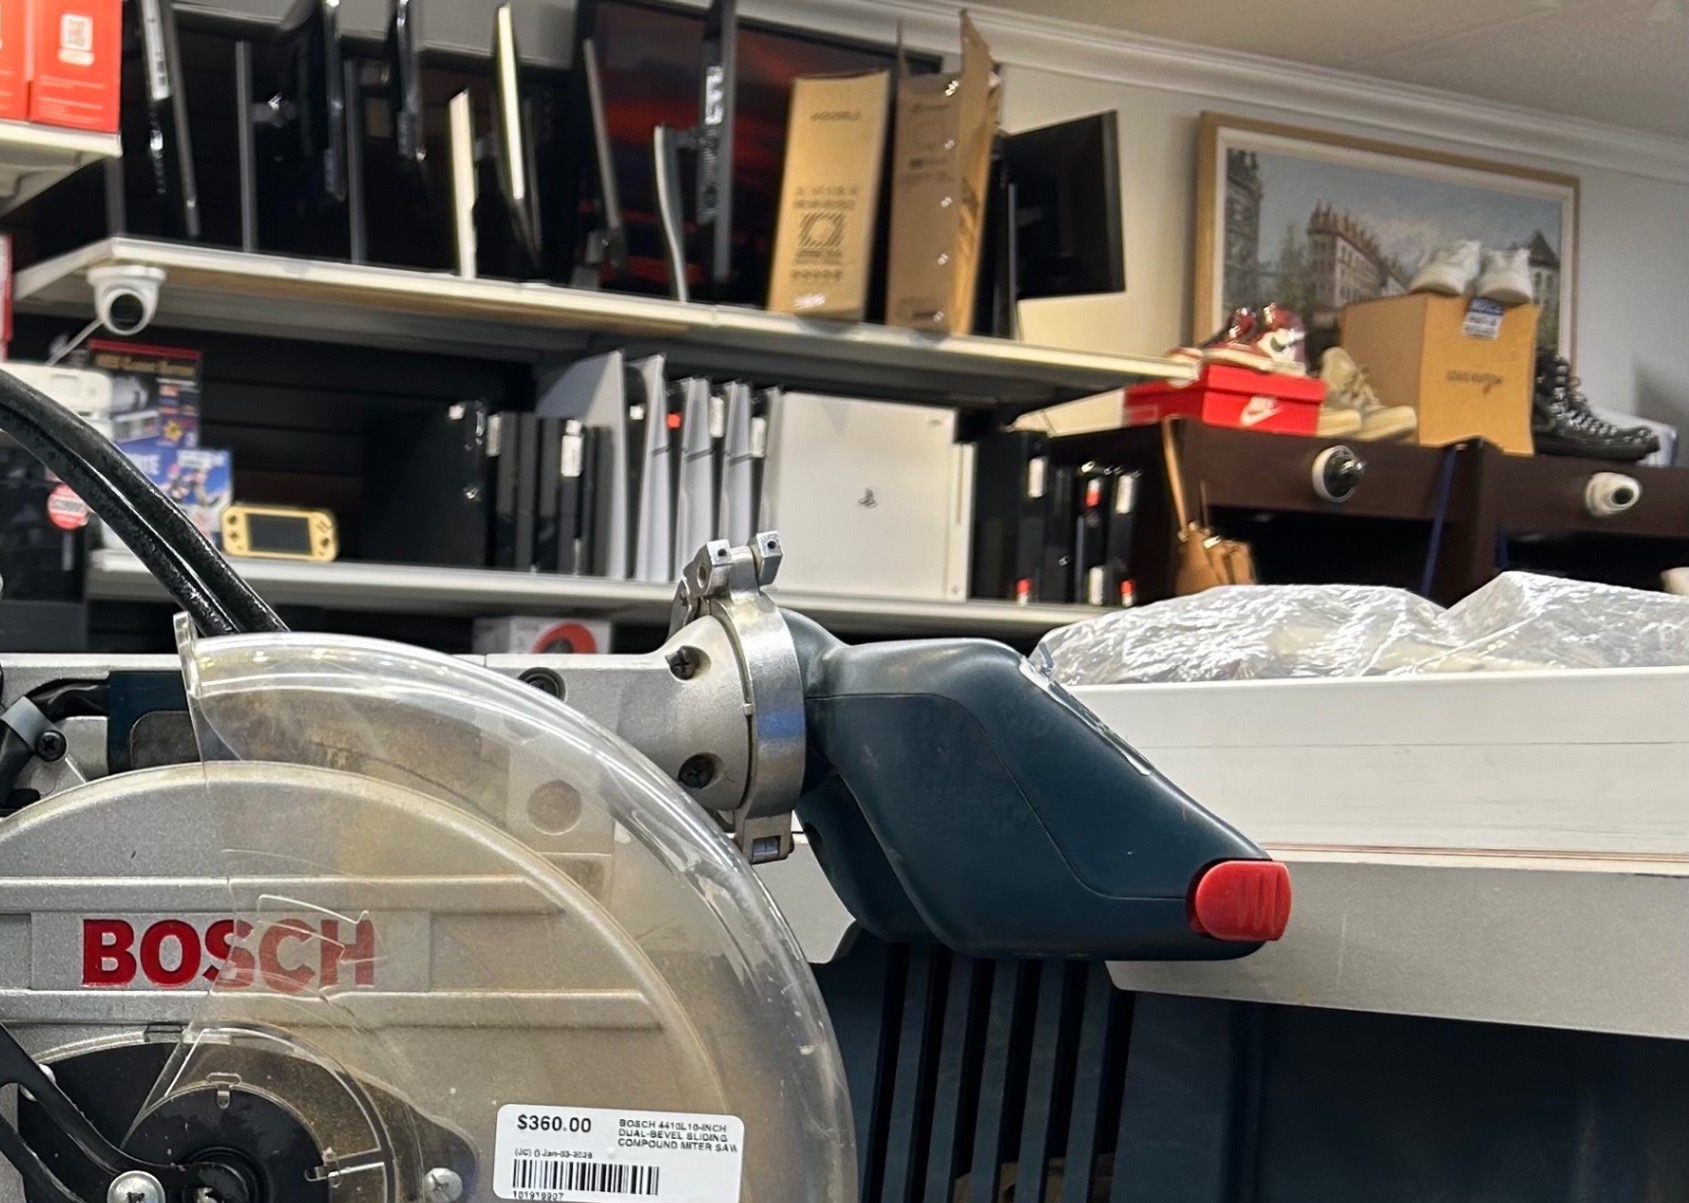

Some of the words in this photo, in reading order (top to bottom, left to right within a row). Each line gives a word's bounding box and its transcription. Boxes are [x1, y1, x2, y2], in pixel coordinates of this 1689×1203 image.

[82, 918, 375, 993] BOSCH
[517, 1113, 592, 1133] $360.00
[619, 1118, 656, 1129] BOSCH
[618, 1128, 683, 1140] DUAL-BEVEL
[686, 1131, 728, 1143] SLIDING
[617, 1138, 678, 1149] COMPOUND
[680, 1141, 713, 1152] MITER
[715, 1143, 737, 1152] SAW
